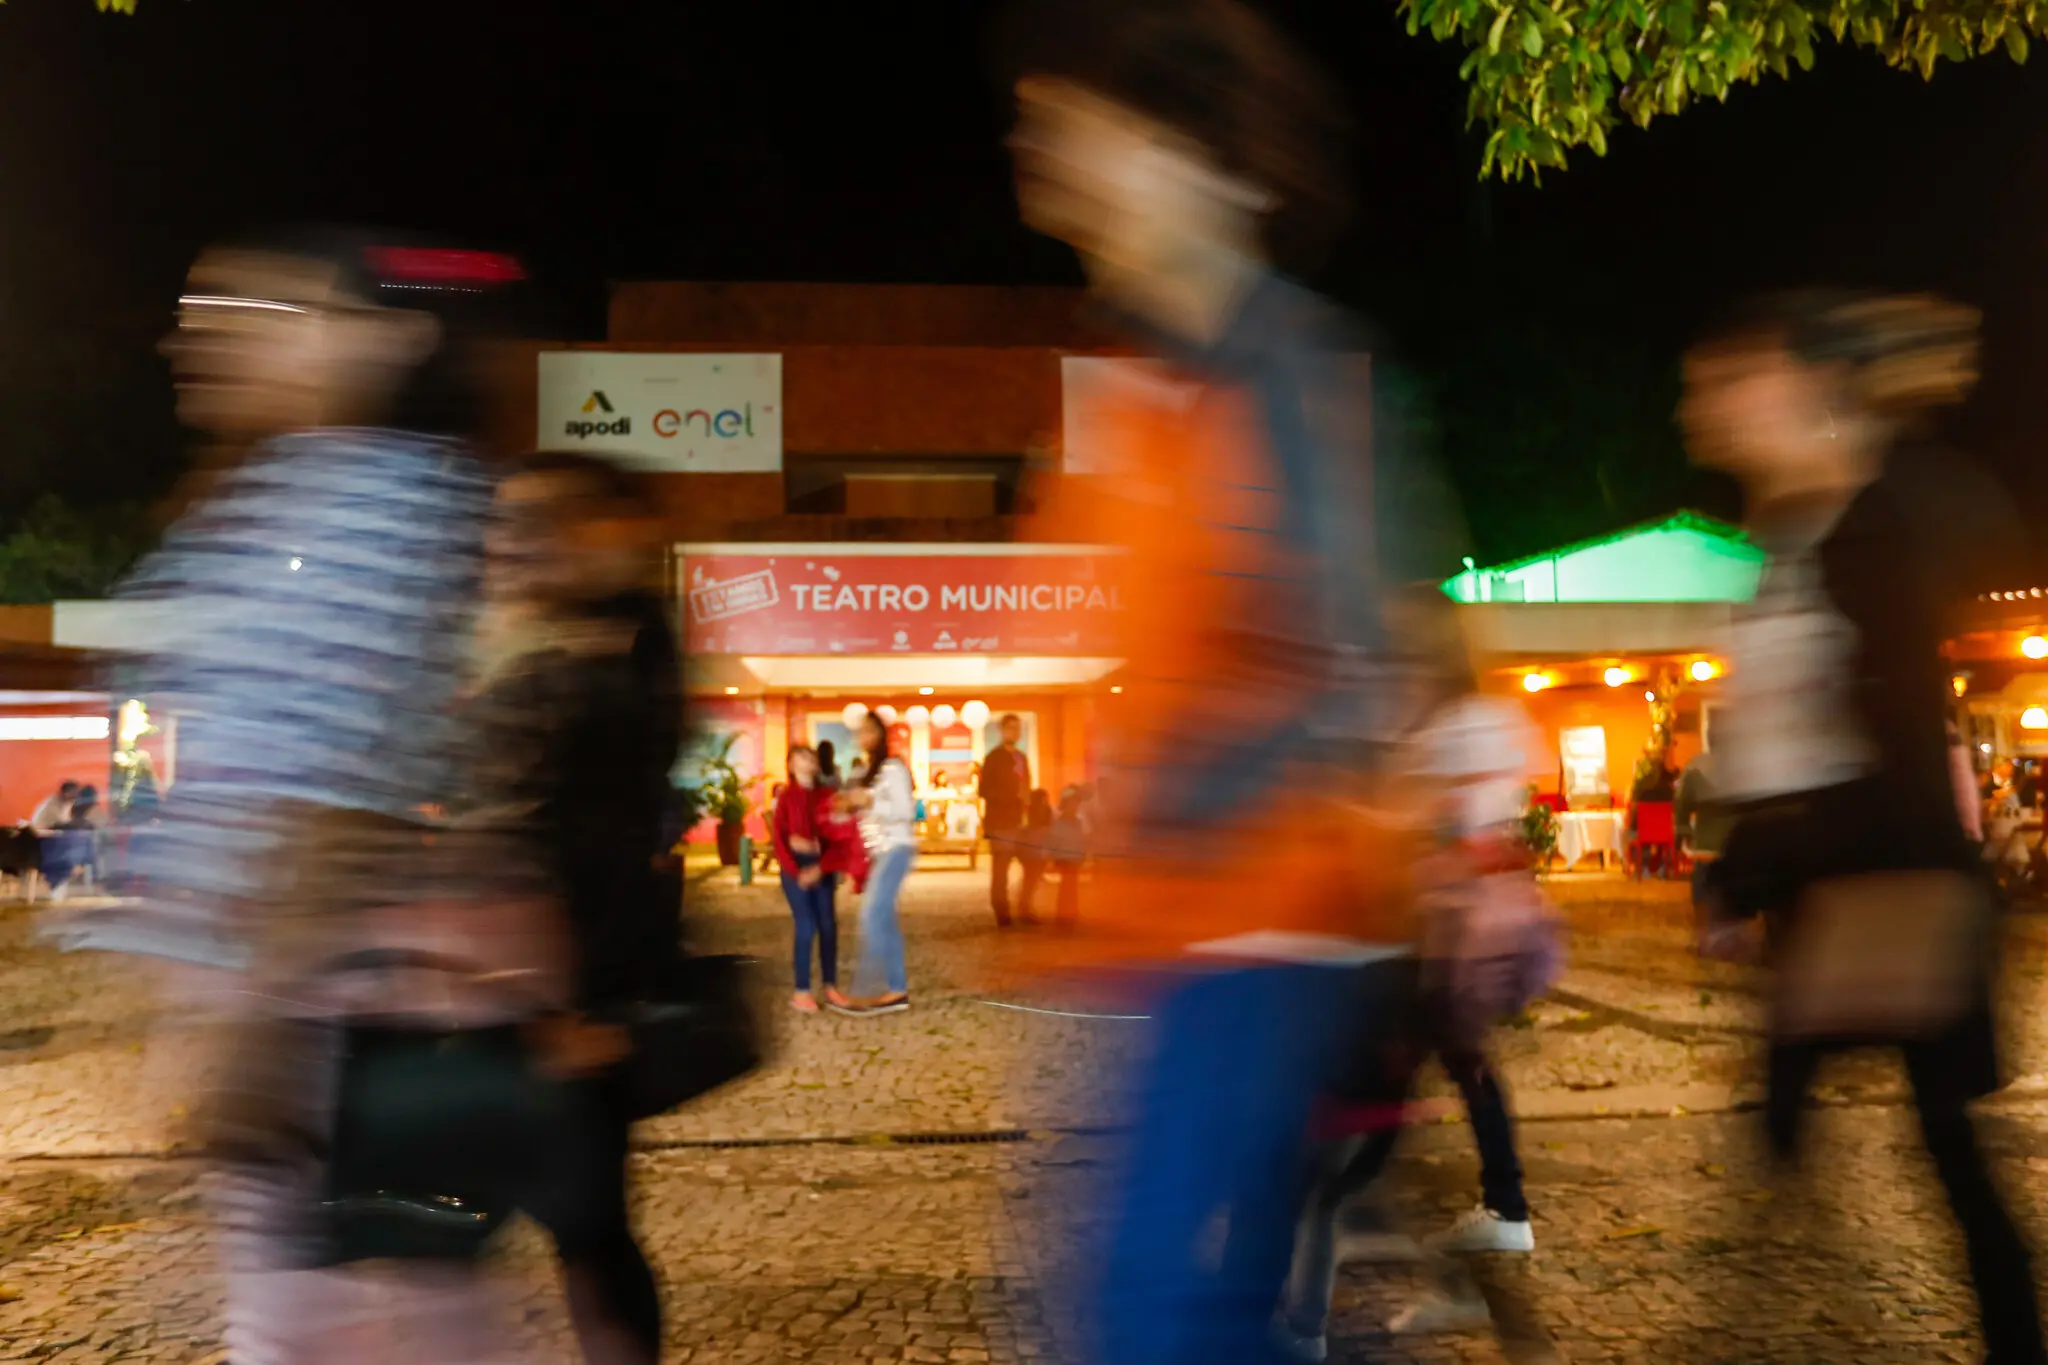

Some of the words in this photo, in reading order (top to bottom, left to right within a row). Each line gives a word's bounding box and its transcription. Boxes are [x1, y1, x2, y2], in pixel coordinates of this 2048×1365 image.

[565, 417, 631, 438] apodi
[652, 402, 755, 438] enel
[789, 584, 930, 612] TEATRO
[940, 584, 1127, 612] MUNICIPAL
